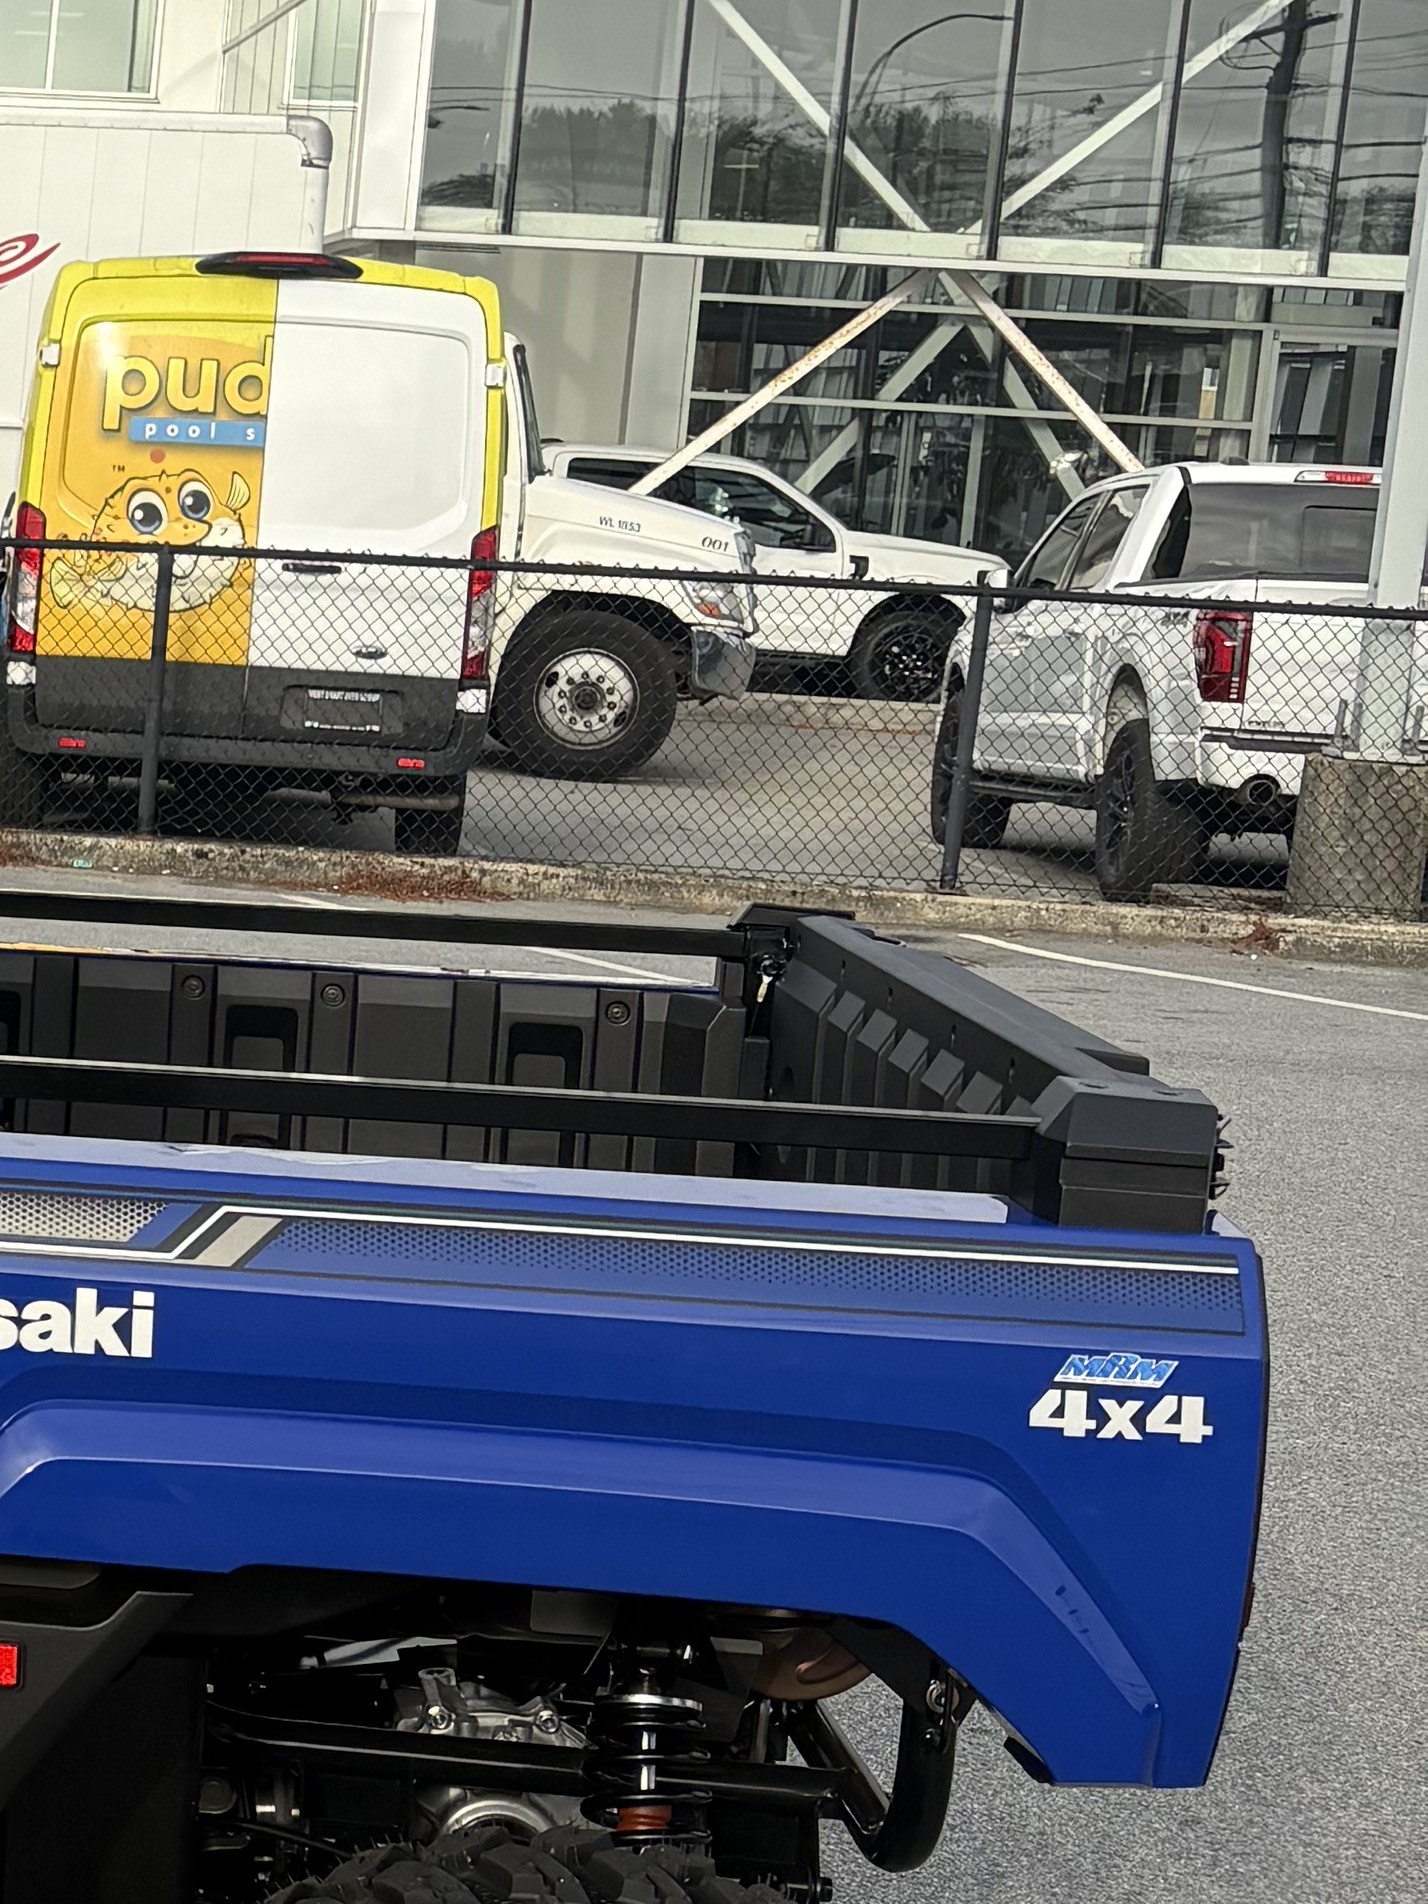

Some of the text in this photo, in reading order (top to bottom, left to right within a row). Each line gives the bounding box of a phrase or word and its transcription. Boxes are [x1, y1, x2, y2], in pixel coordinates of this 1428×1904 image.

[102, 335, 274, 431] pud
[145, 421, 216, 439] pool
[1028, 1388, 1214, 1444] 4x4
